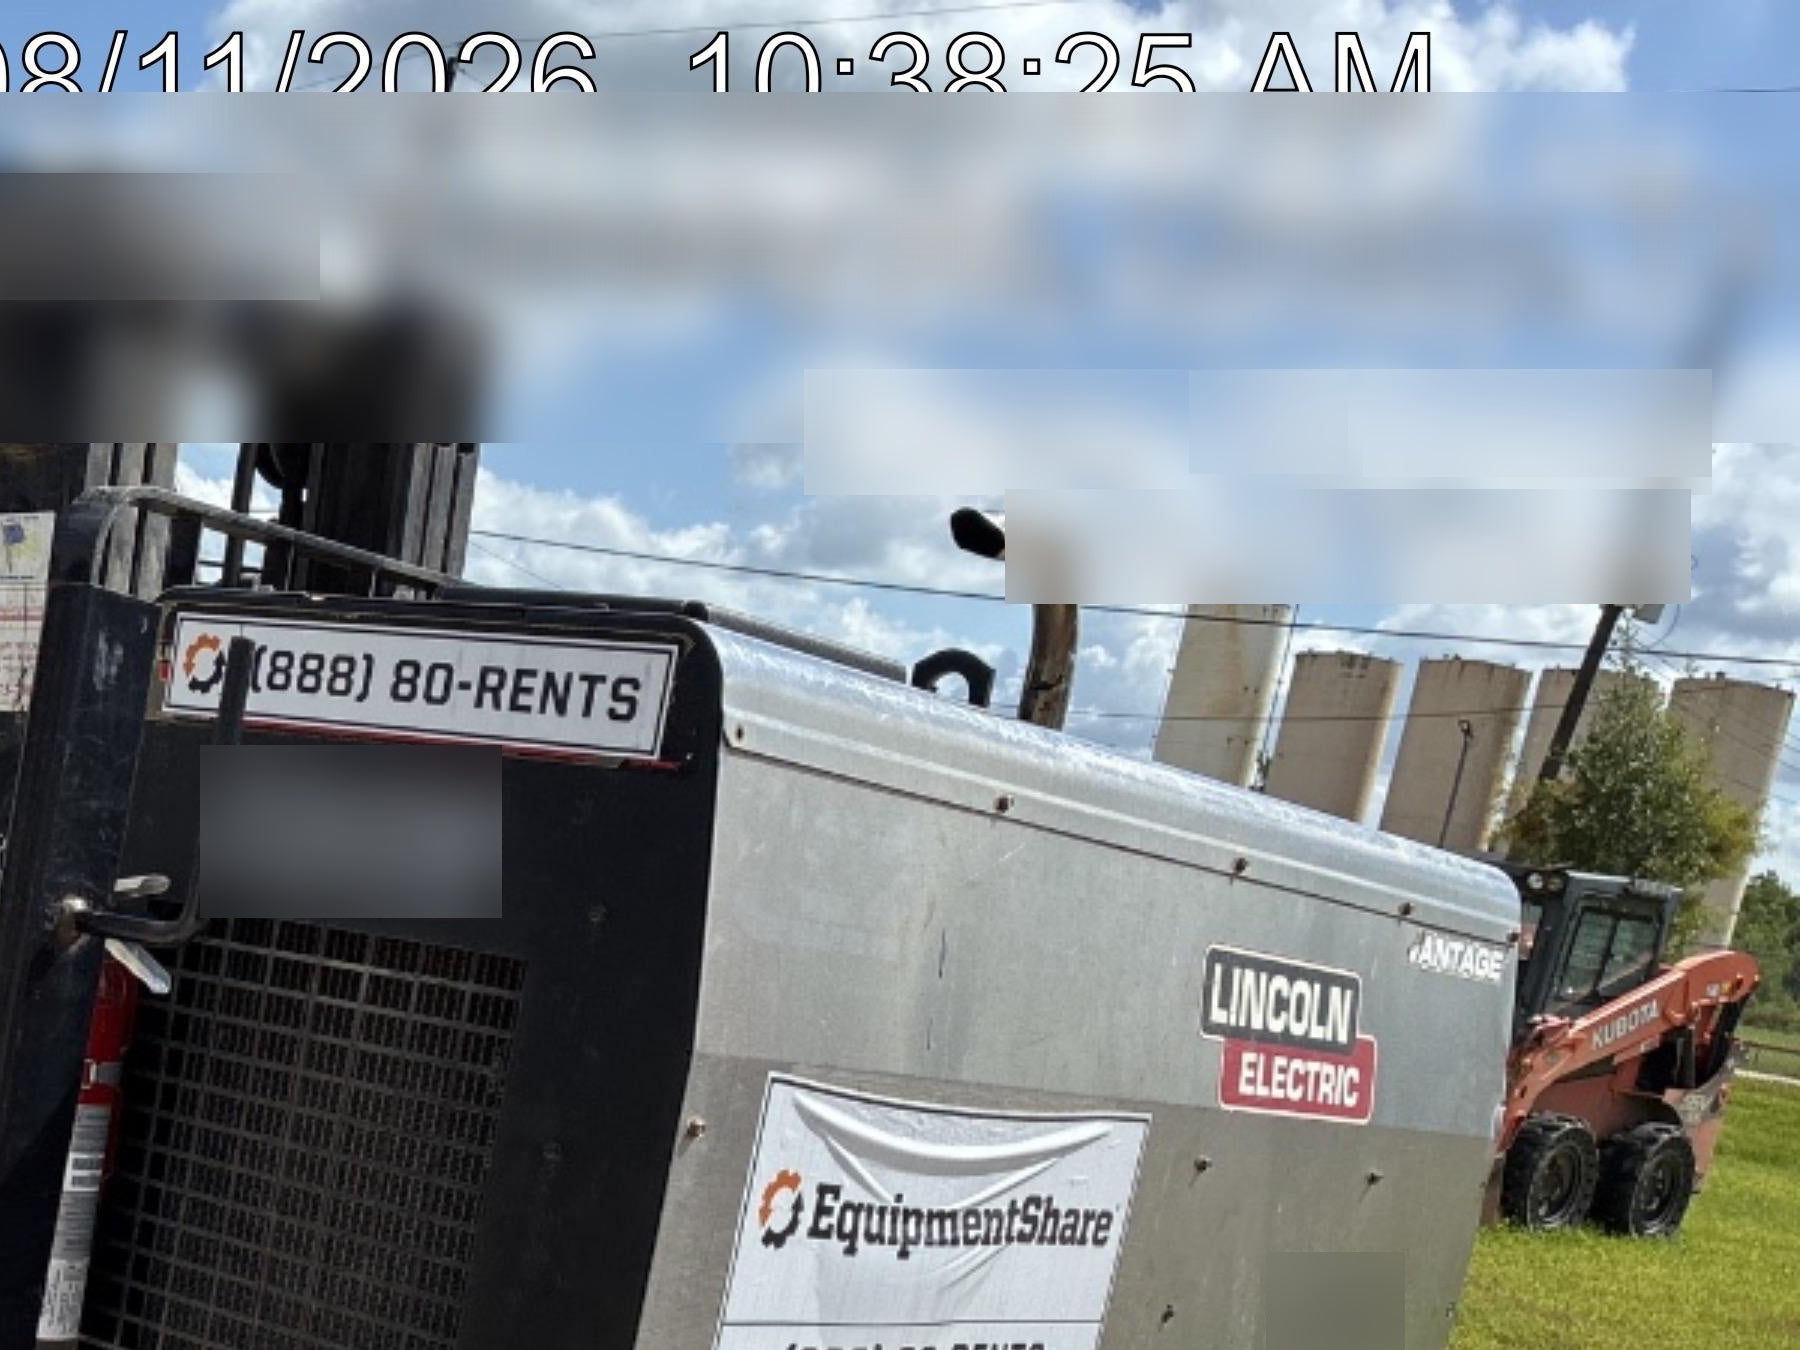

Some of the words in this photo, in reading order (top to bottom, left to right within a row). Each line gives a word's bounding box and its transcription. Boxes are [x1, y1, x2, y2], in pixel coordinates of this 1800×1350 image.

[251, 645, 374, 703] (888)
[390, 659, 643, 722] 80-RENTS
[1210, 962, 1354, 1045] LINCOLN
[1592, 999, 1660, 1051] KUBOTA
[1238, 1051, 1360, 1107] ELECTRIC
[806, 1182, 1114, 1261] EquipmentShare
